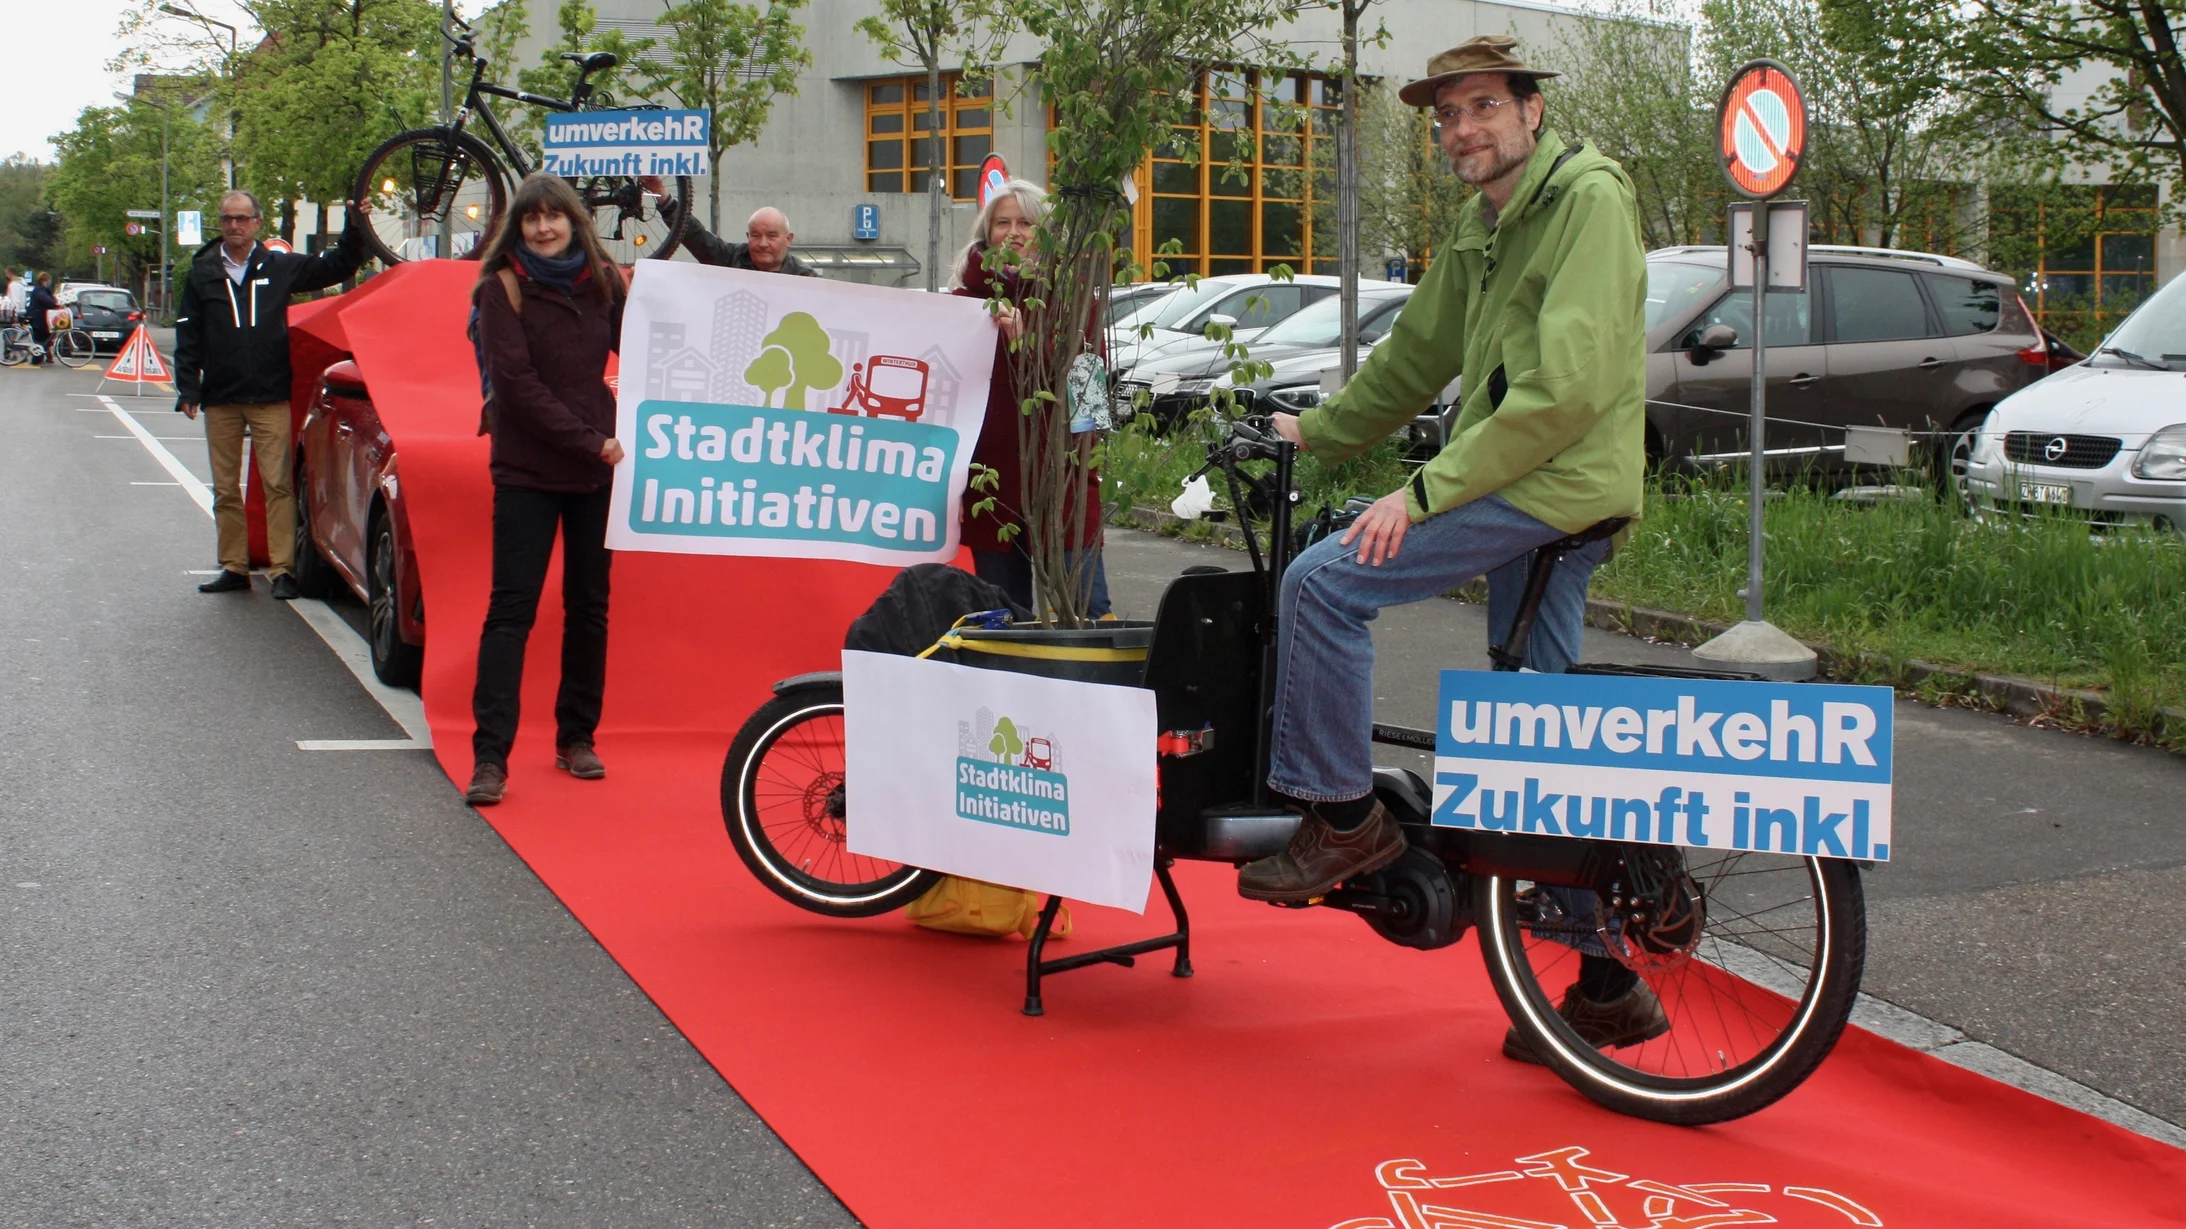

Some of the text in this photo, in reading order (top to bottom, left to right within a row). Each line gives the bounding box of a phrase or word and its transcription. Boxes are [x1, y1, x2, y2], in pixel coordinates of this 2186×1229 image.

[549, 115, 704, 143] umverkehR
[544, 151, 707, 177] Zukunft inkl.
[644, 413, 947, 483] Stadtklima
[641, 477, 937, 542] Initiativen
[1450, 696, 1878, 766] umverkehR
[959, 762, 1064, 800] Stadtklima
[959, 793, 1066, 830] Initiativen
[1433, 773, 1889, 860] Zukunft inkl.
